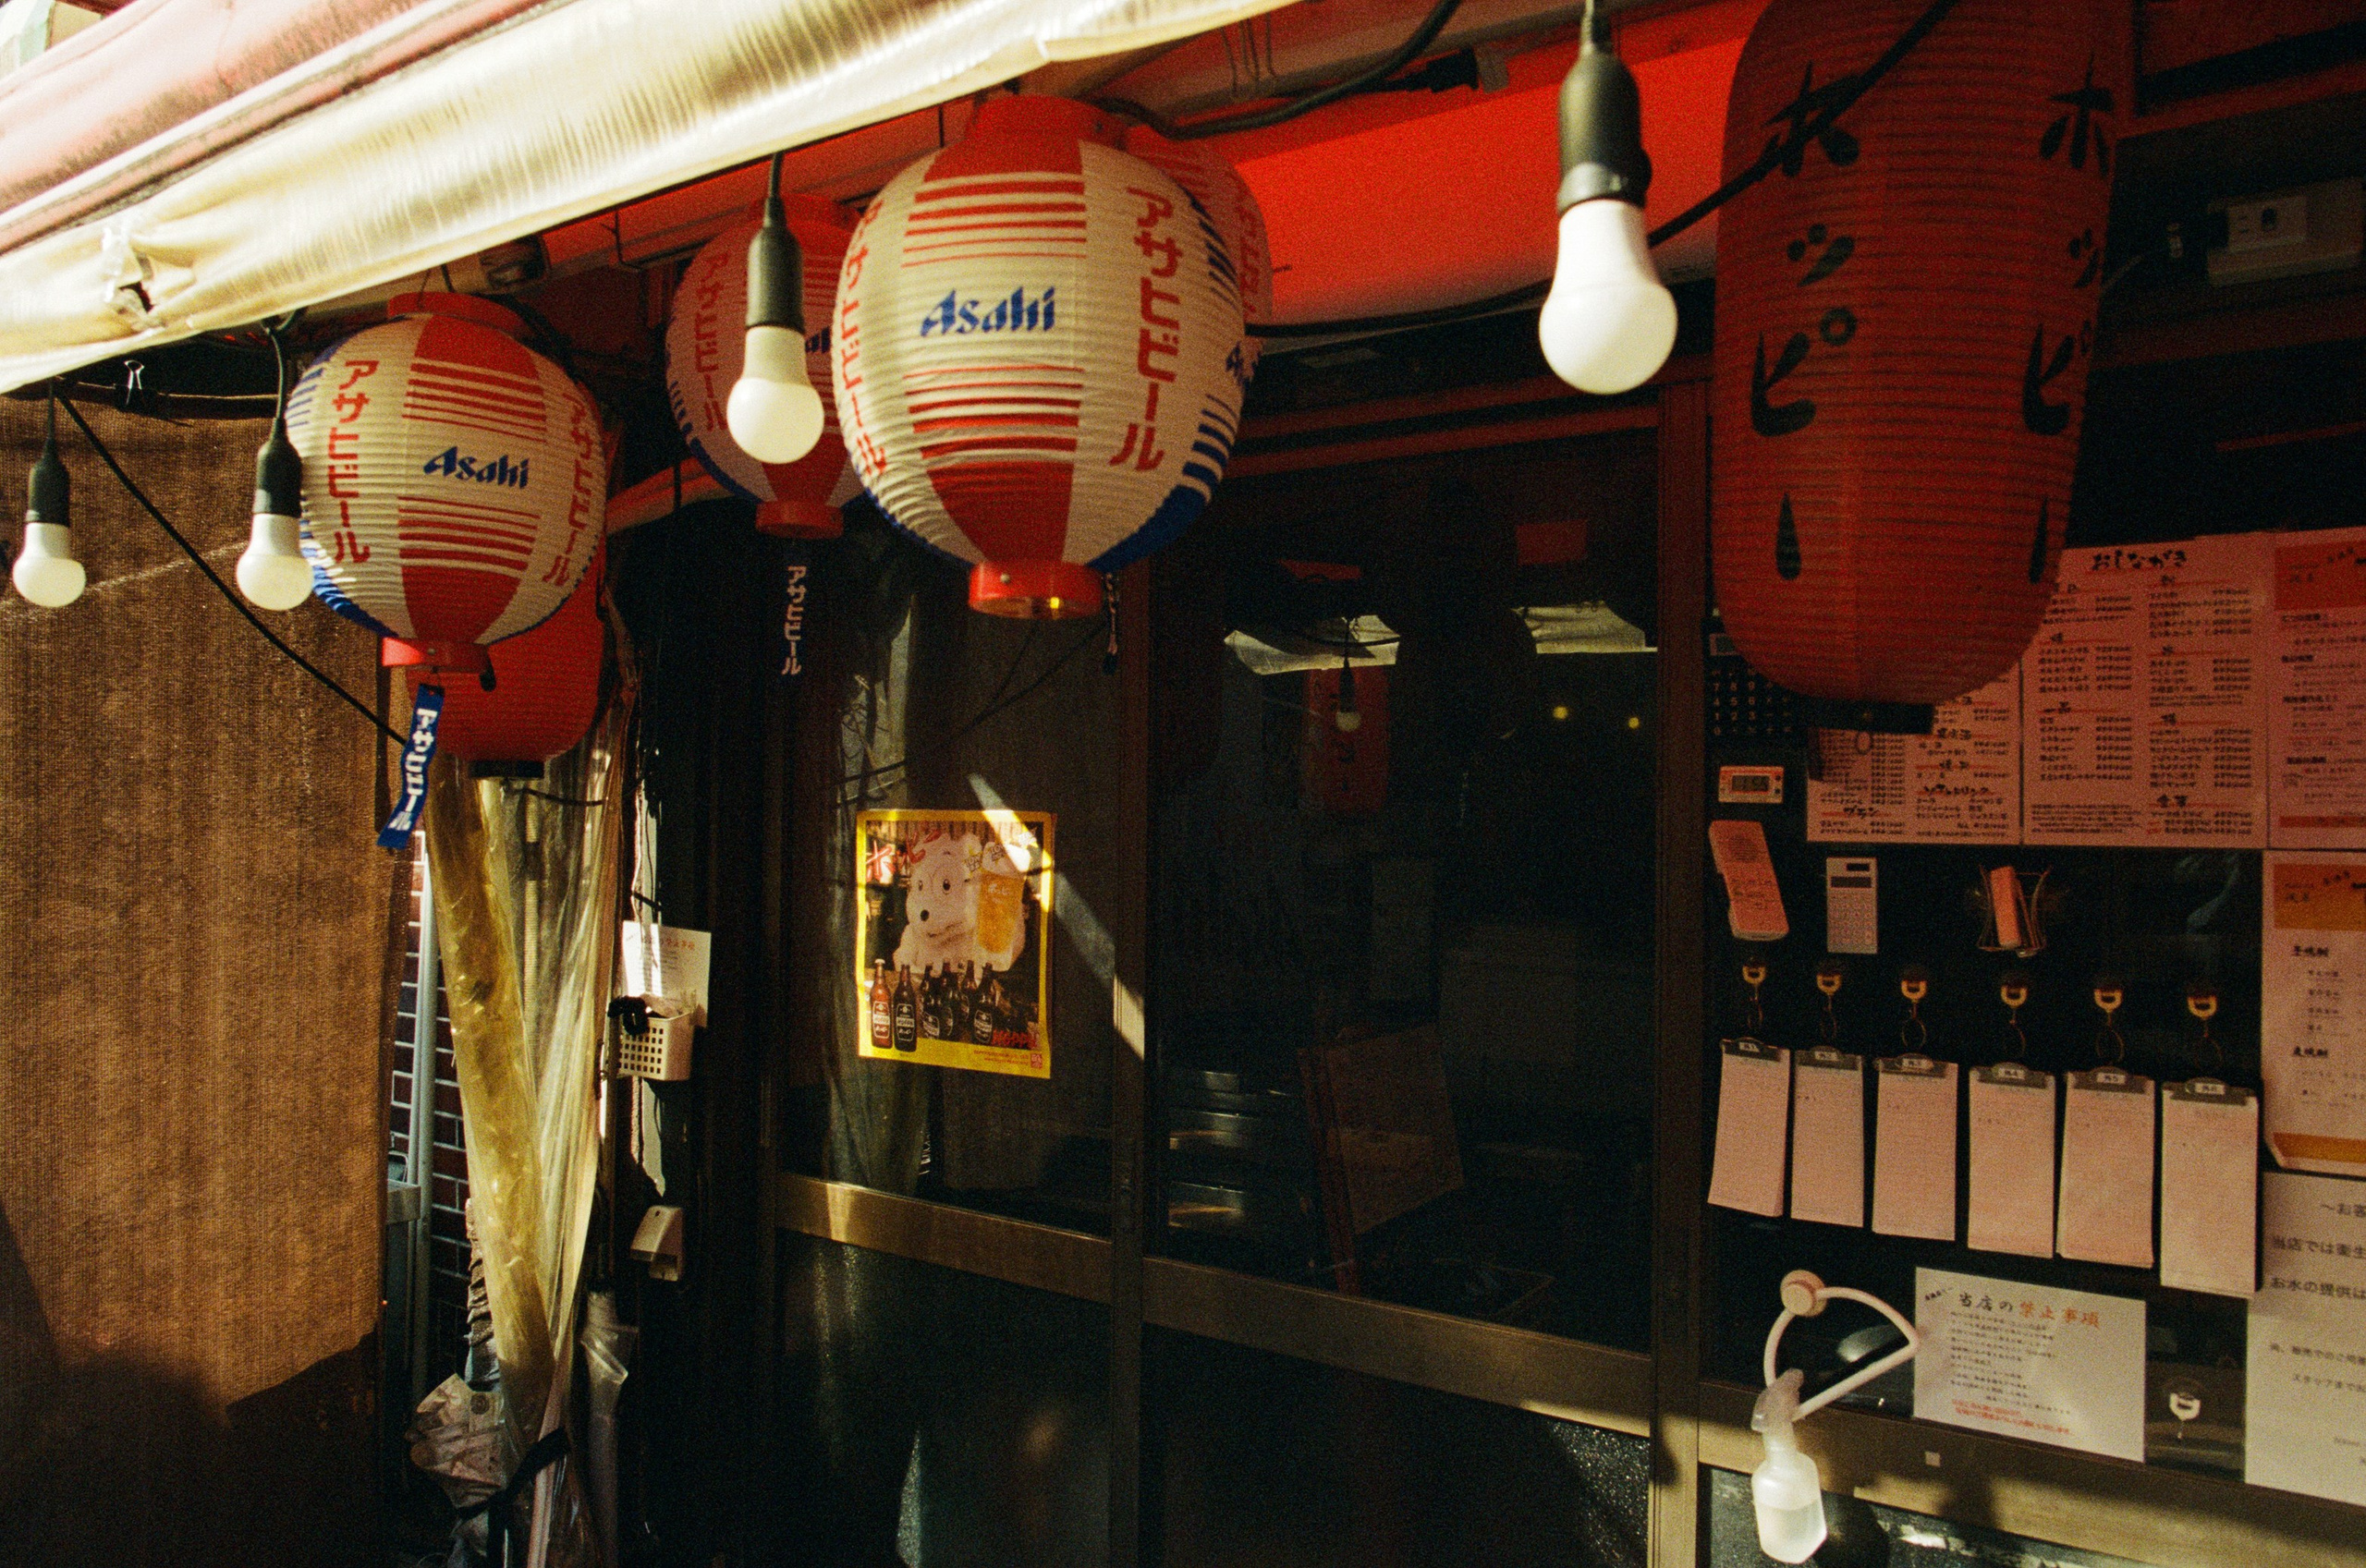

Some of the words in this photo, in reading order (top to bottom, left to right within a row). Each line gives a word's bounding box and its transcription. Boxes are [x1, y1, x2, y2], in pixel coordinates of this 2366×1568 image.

[920, 286, 1056, 338] Asahi
[1110, 186, 1183, 472] アサヒビール
[1750, 60, 1860, 581] ホッピー
[328, 359, 380, 564] アサヒビール
[422, 444, 530, 490] Asahi
[782, 565, 808, 675] アサヒビール
